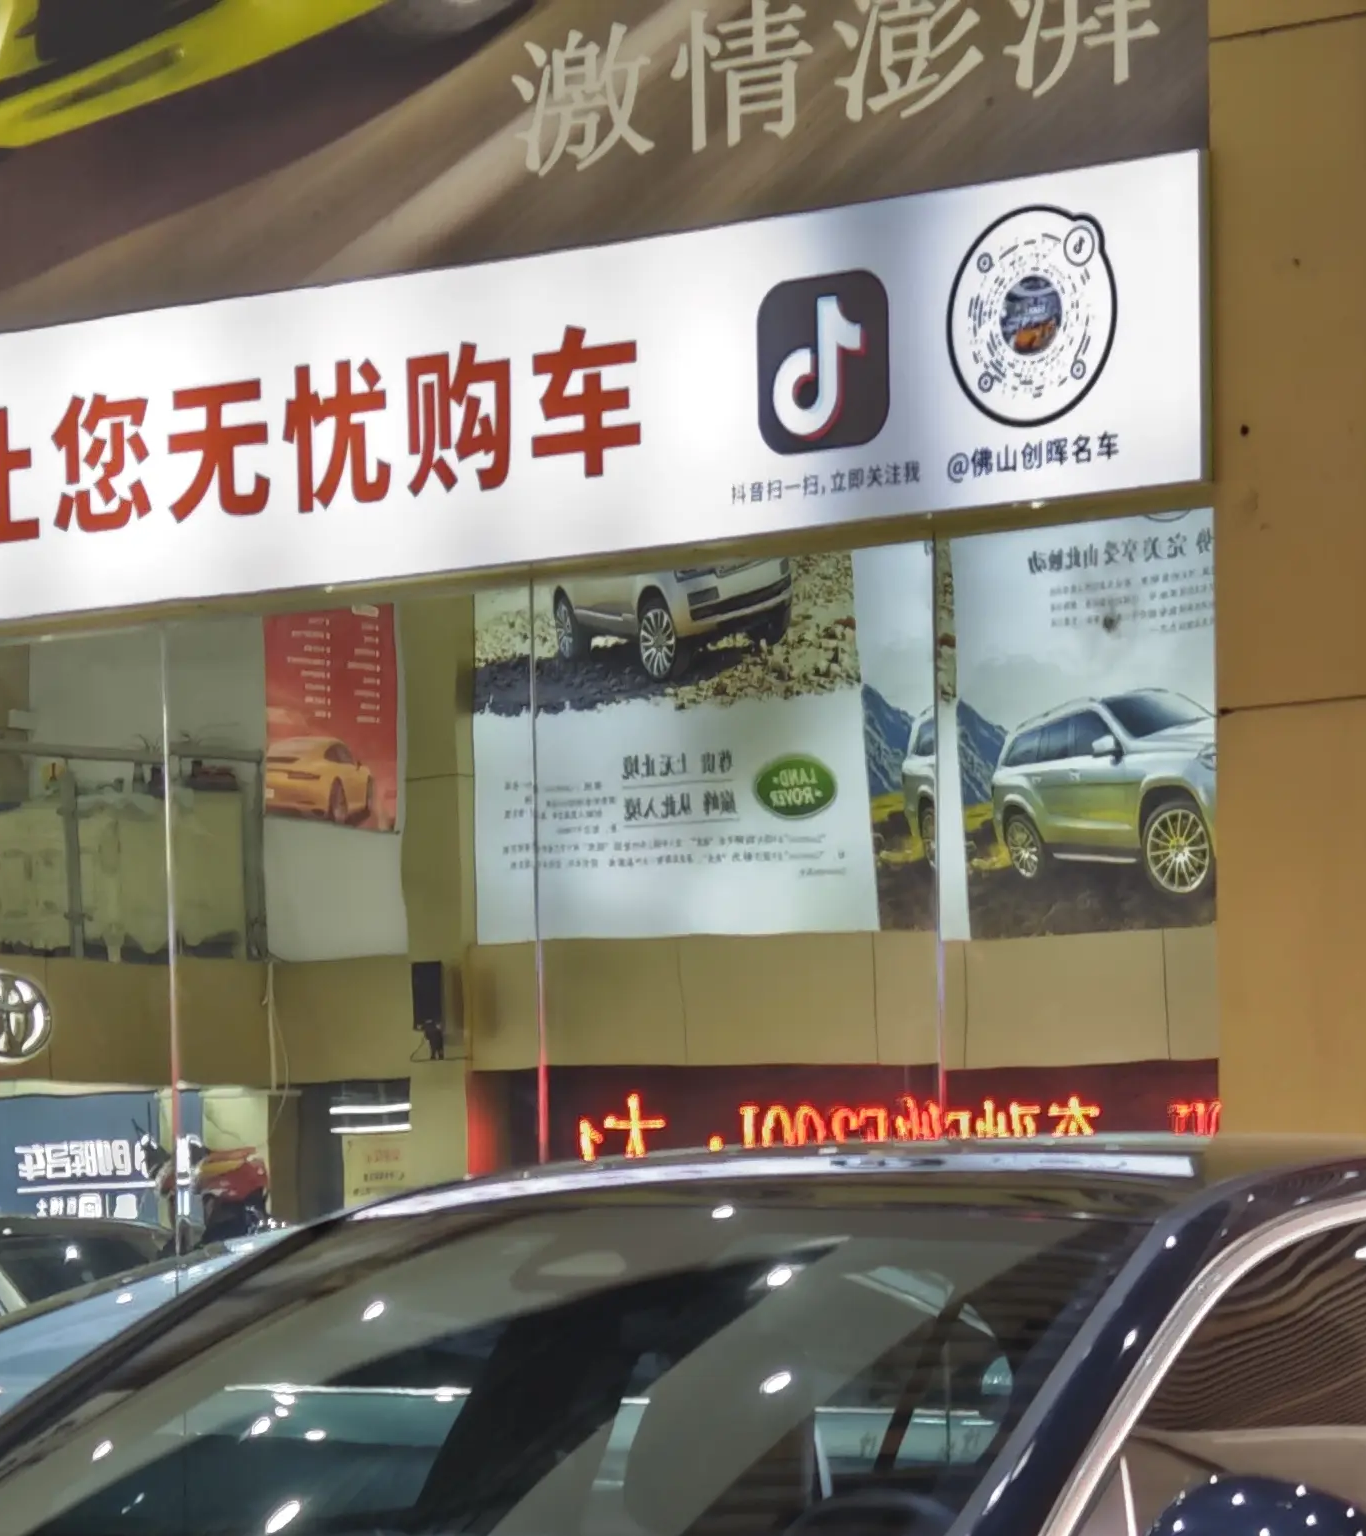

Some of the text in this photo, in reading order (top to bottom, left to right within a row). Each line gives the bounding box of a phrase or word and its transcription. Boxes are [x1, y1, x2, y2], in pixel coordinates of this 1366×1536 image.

[512, 0, 1162, 178] 激情澎湃
[947, 431, 1120, 483] @佛山创晖名车
